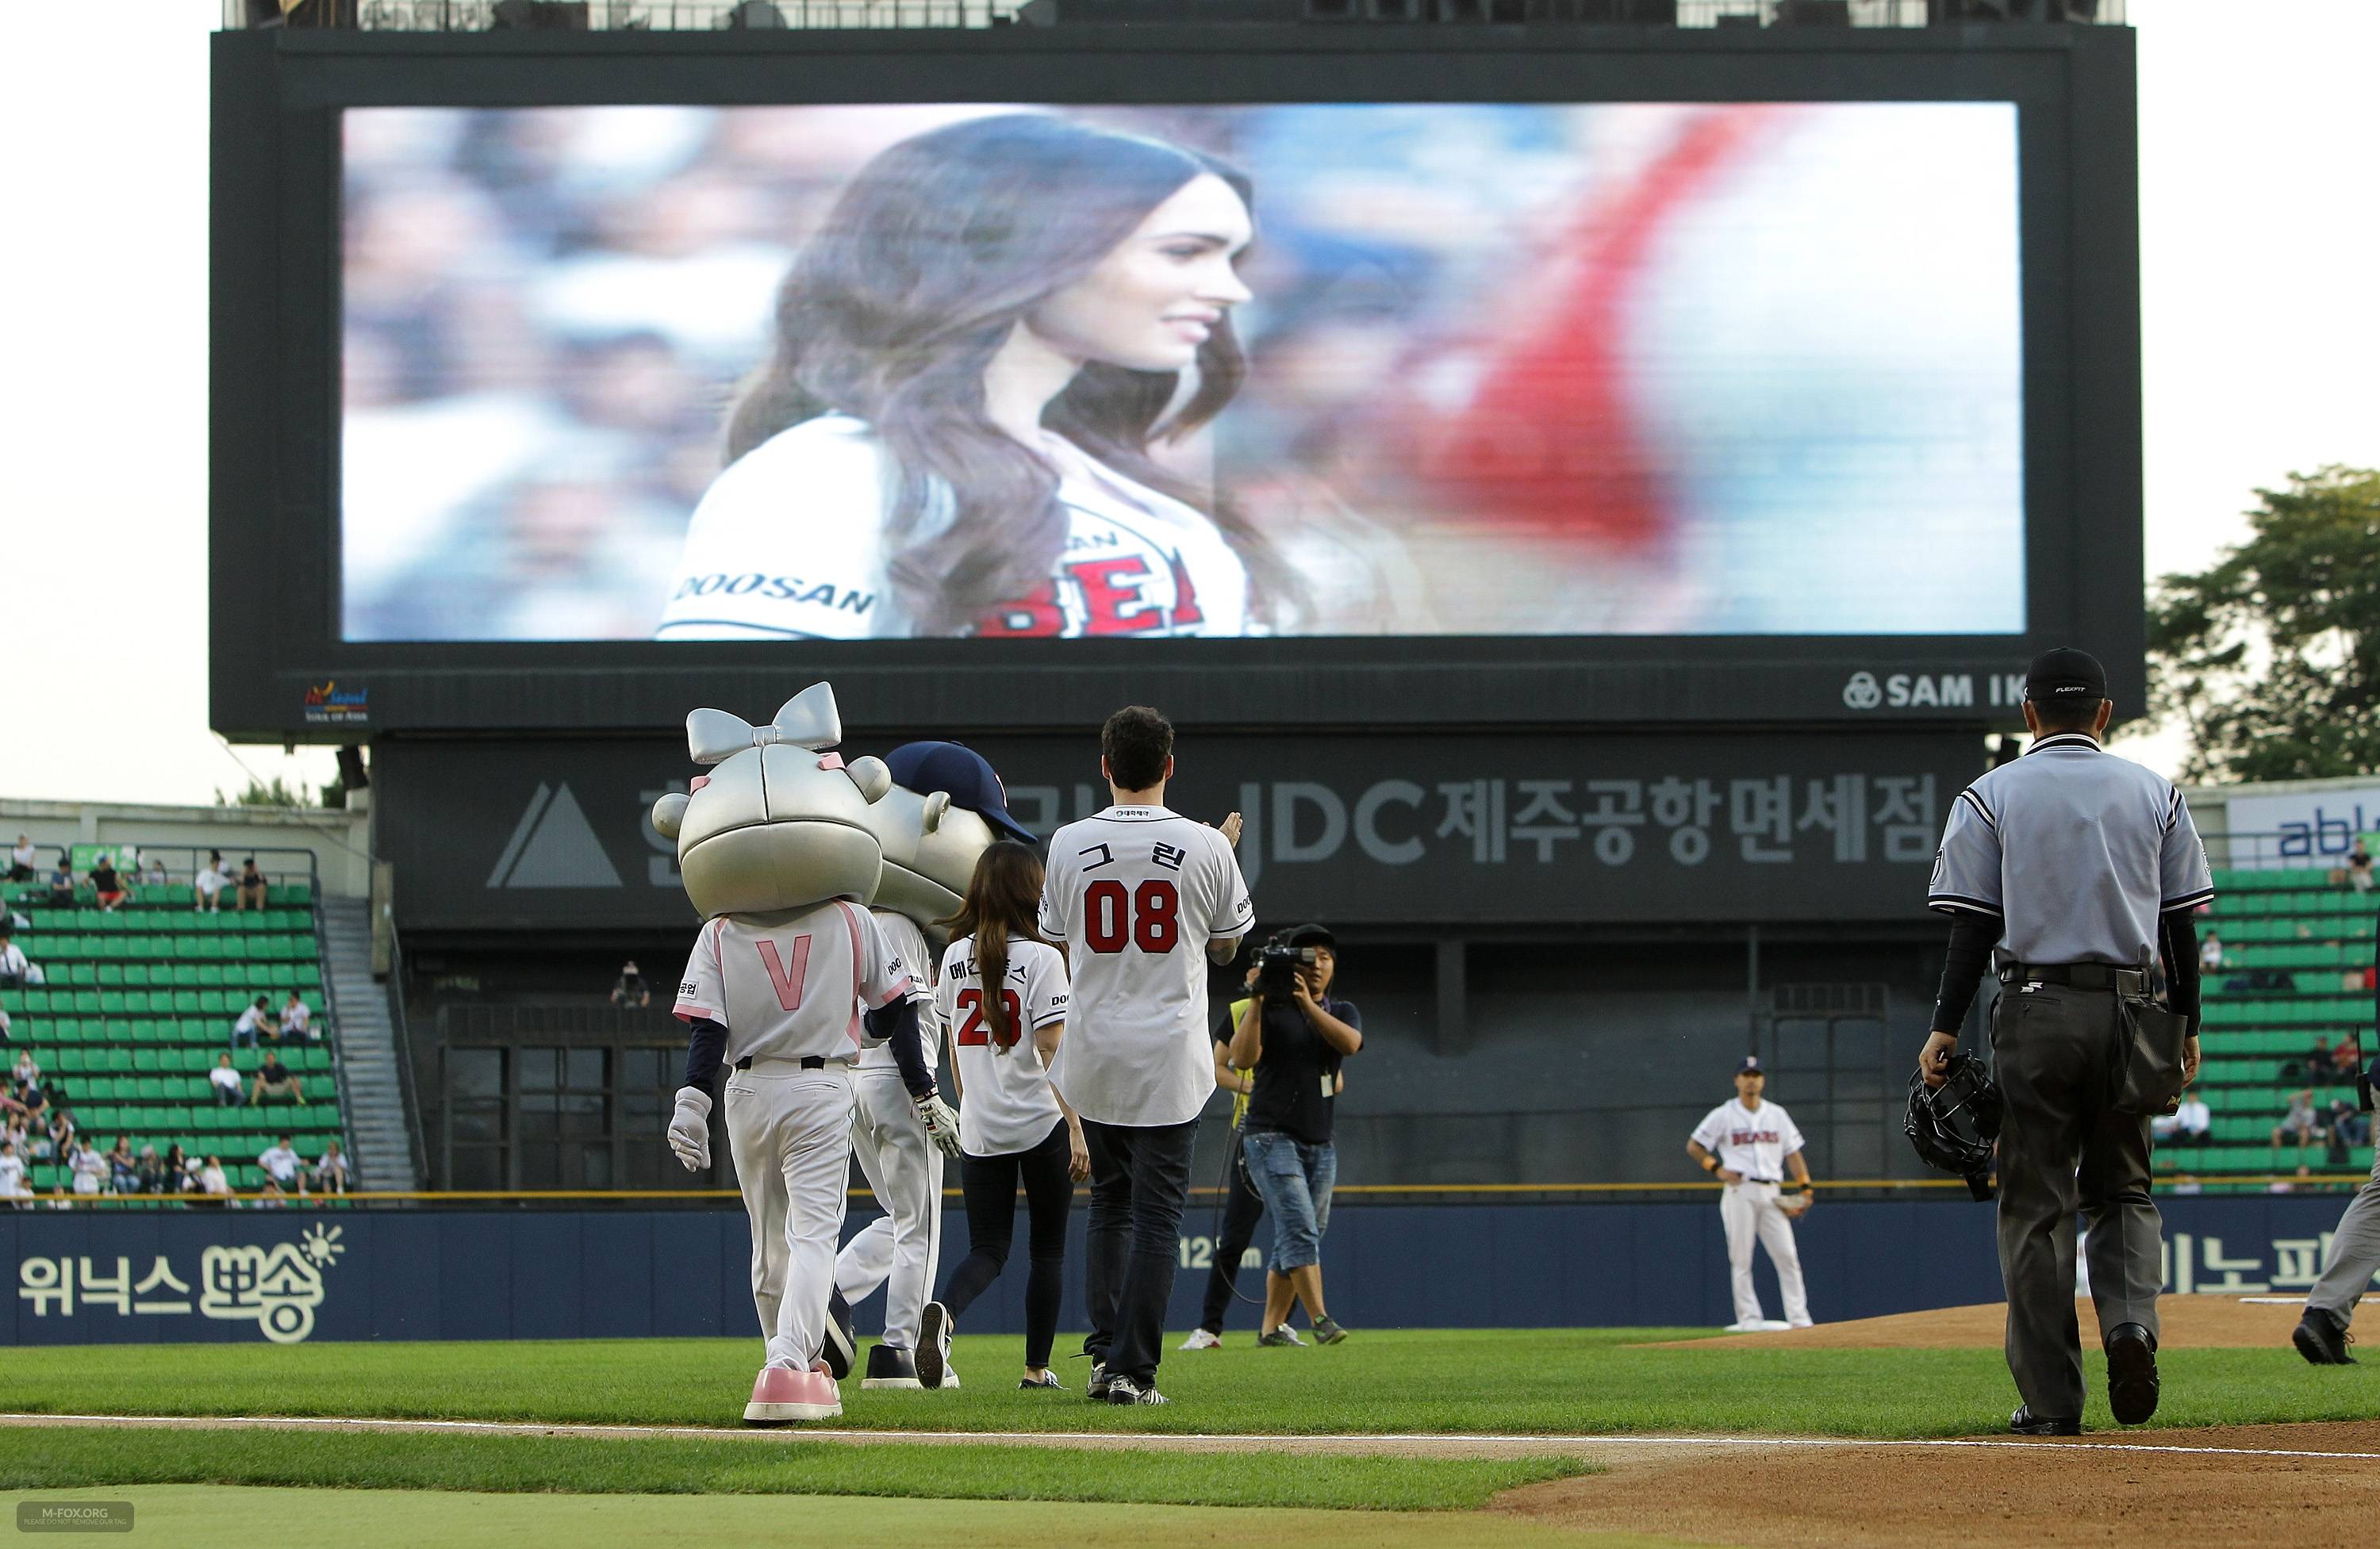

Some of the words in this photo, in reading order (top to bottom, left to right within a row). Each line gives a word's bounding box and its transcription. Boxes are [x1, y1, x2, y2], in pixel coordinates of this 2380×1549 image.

[674, 573, 873, 615] DOOSAN
[1887, 673, 1973, 707] SAM
[1437, 773, 1937, 868] 제주공항면세점
[1084, 879, 1179, 954] 08
[679, 983, 697, 995] 공업
[756, 934, 812, 1011] V
[888, 957, 902, 976] DOO
[18, 1256, 192, 1317] 위닉스
